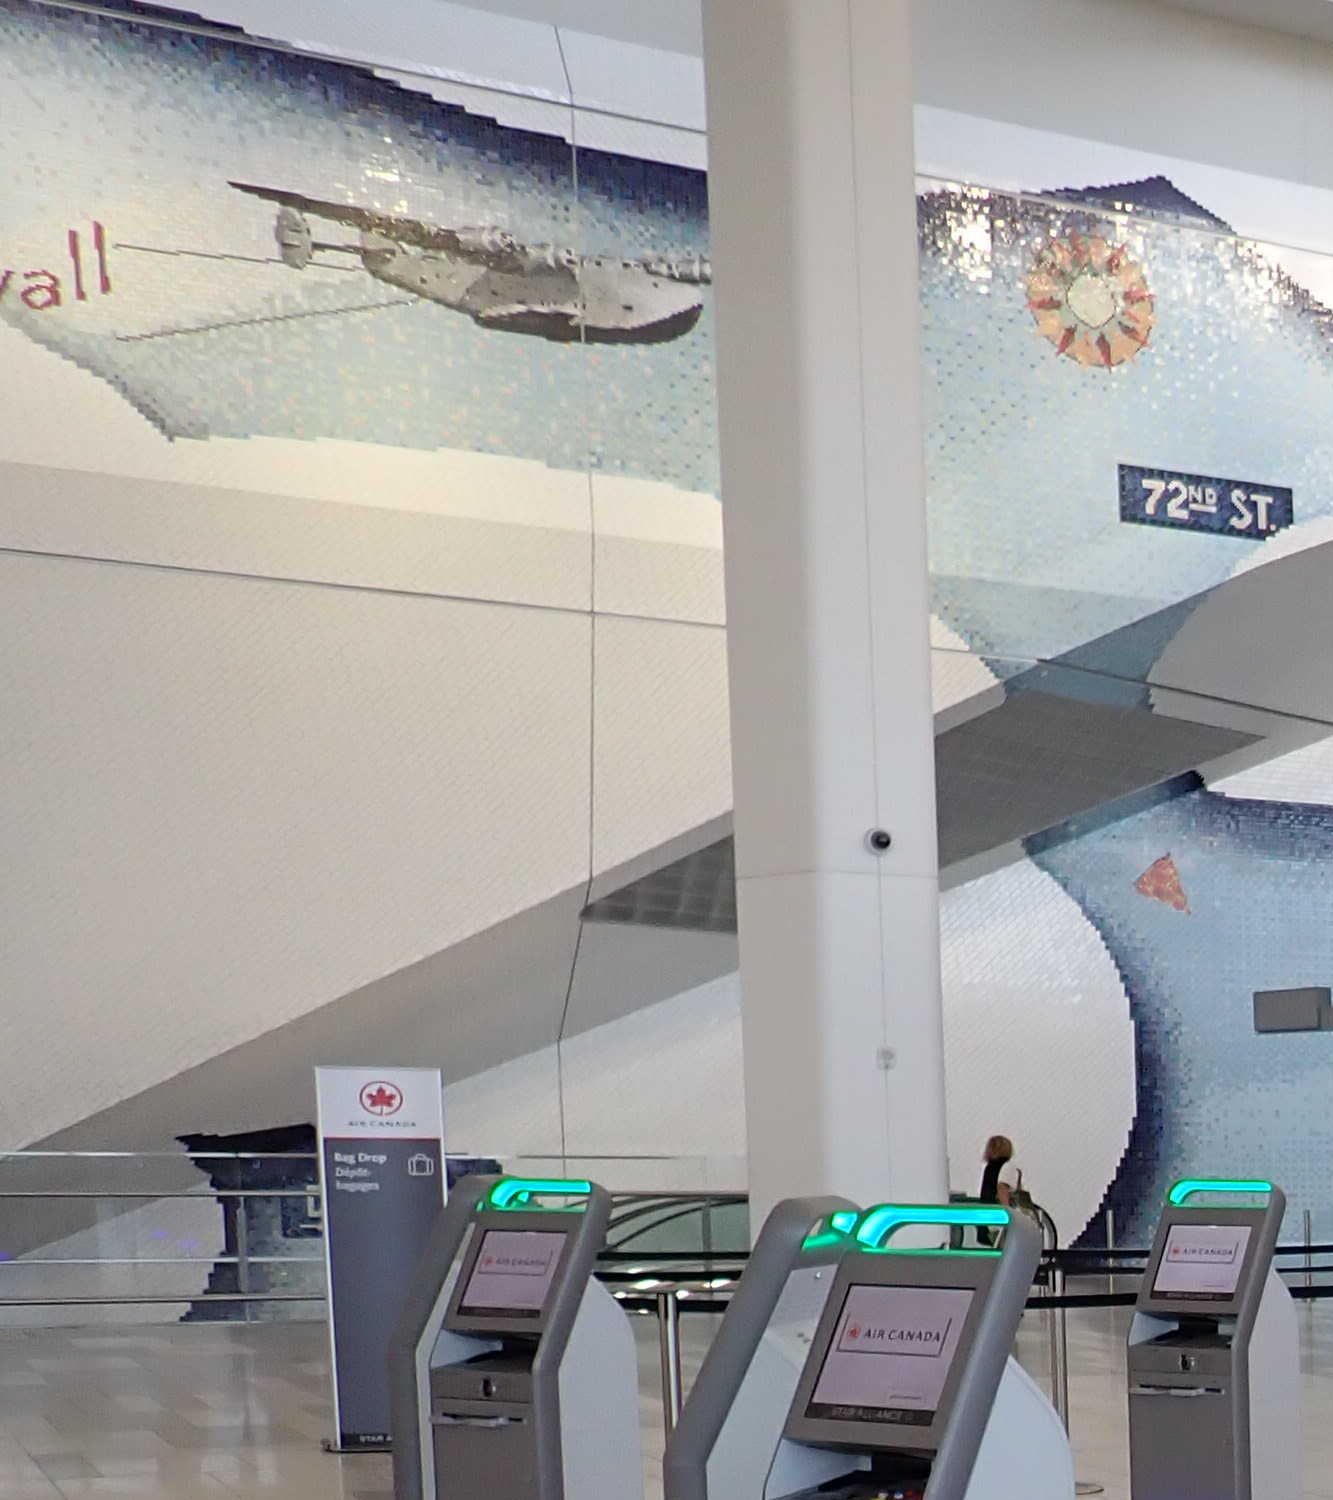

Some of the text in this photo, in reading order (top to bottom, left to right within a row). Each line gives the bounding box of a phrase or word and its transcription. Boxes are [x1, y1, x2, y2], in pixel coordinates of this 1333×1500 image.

[1141, 479, 1278, 531] 72ND ST.
[863, 1327, 941, 1342] AIR CANADA
